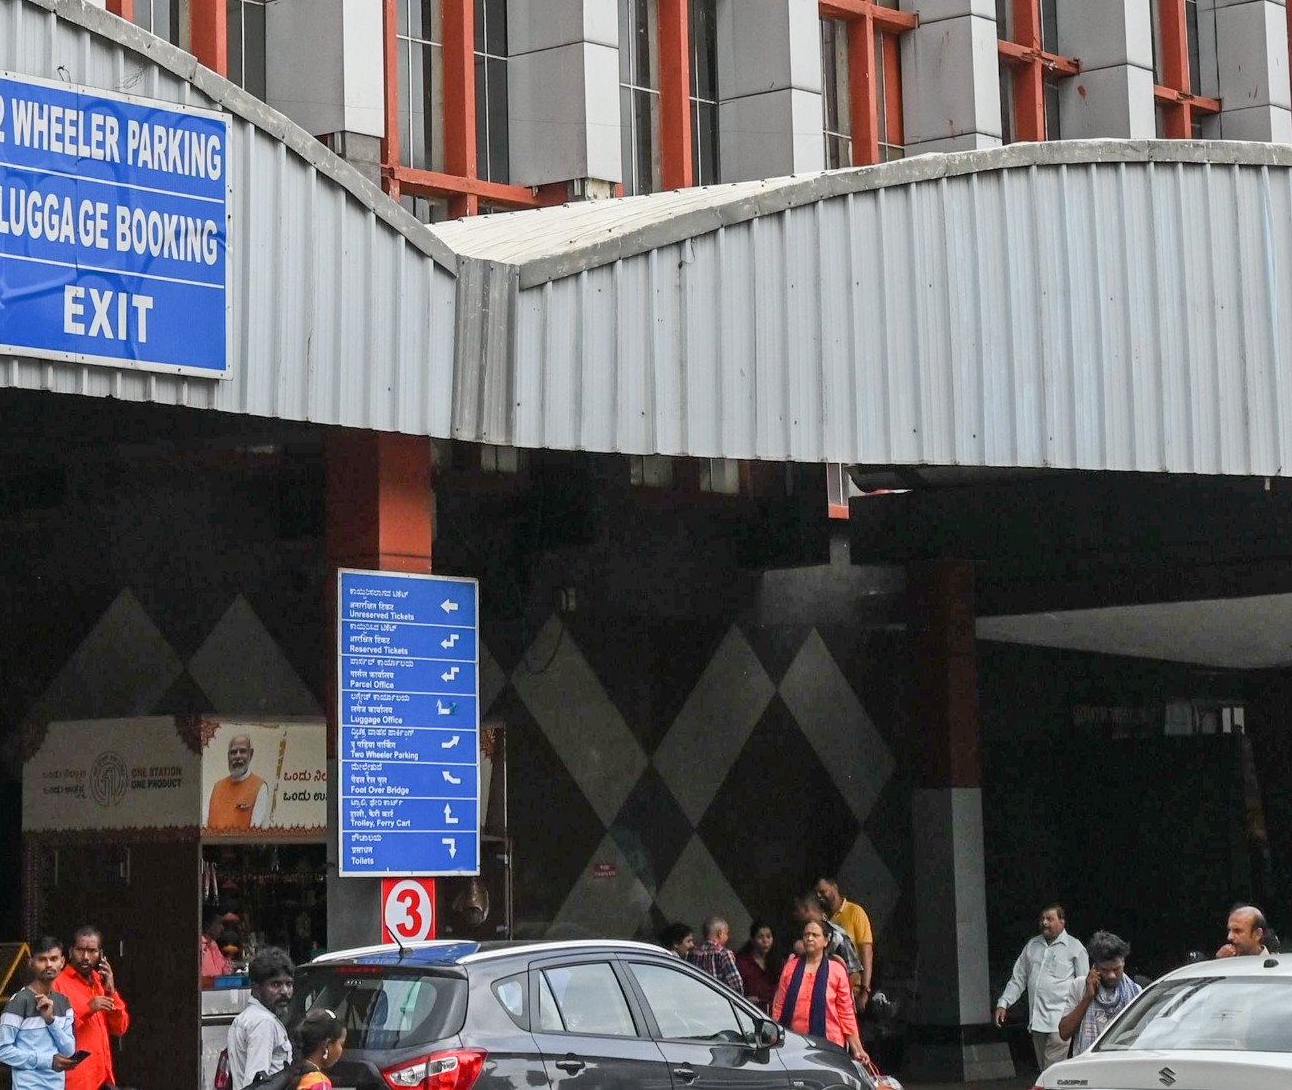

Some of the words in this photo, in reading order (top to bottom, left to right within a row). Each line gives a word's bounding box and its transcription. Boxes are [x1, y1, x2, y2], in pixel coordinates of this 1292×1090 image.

[13, 100, 120, 164] WHEELER
[127, 119, 221, 181] PARKING
[116, 205, 218, 266] BOOKING
[64, 285, 154, 343] EXIT
[349, 610, 389, 620] Unreserved
[390, 612, 415, 621] Tickets
[349, 644, 382, 654] Reserved
[383, 646, 408, 655] Tickets
[350, 680, 372, 688] Parcel
[373, 680, 394, 689] Office
[350, 715, 381, 725] Luggage
[382, 716, 403, 724] Office
[350, 750, 364, 759] Two
[365, 751, 392, 759] Wheeler
[393, 751, 419, 761] Parking
[131, 768, 147, 778] ONE
[148, 766, 182, 777] STATION
[283, 770, 311, 781] ಒಂದು
[131, 779, 147, 789] ONE
[148, 778, 182, 789] PRODUCT
[283, 790, 311, 801] ಒಂದು
[350, 786, 367, 794] Foot
[368, 786, 385, 794] Over
[386, 786, 410, 796] Bridge
[350, 819, 376, 828] Trolley,
[376, 819, 395, 828] Ferry
[396, 819, 411, 827] Cart
[351, 857, 374, 865] Toilets
[396, 886, 421, 939] 3
